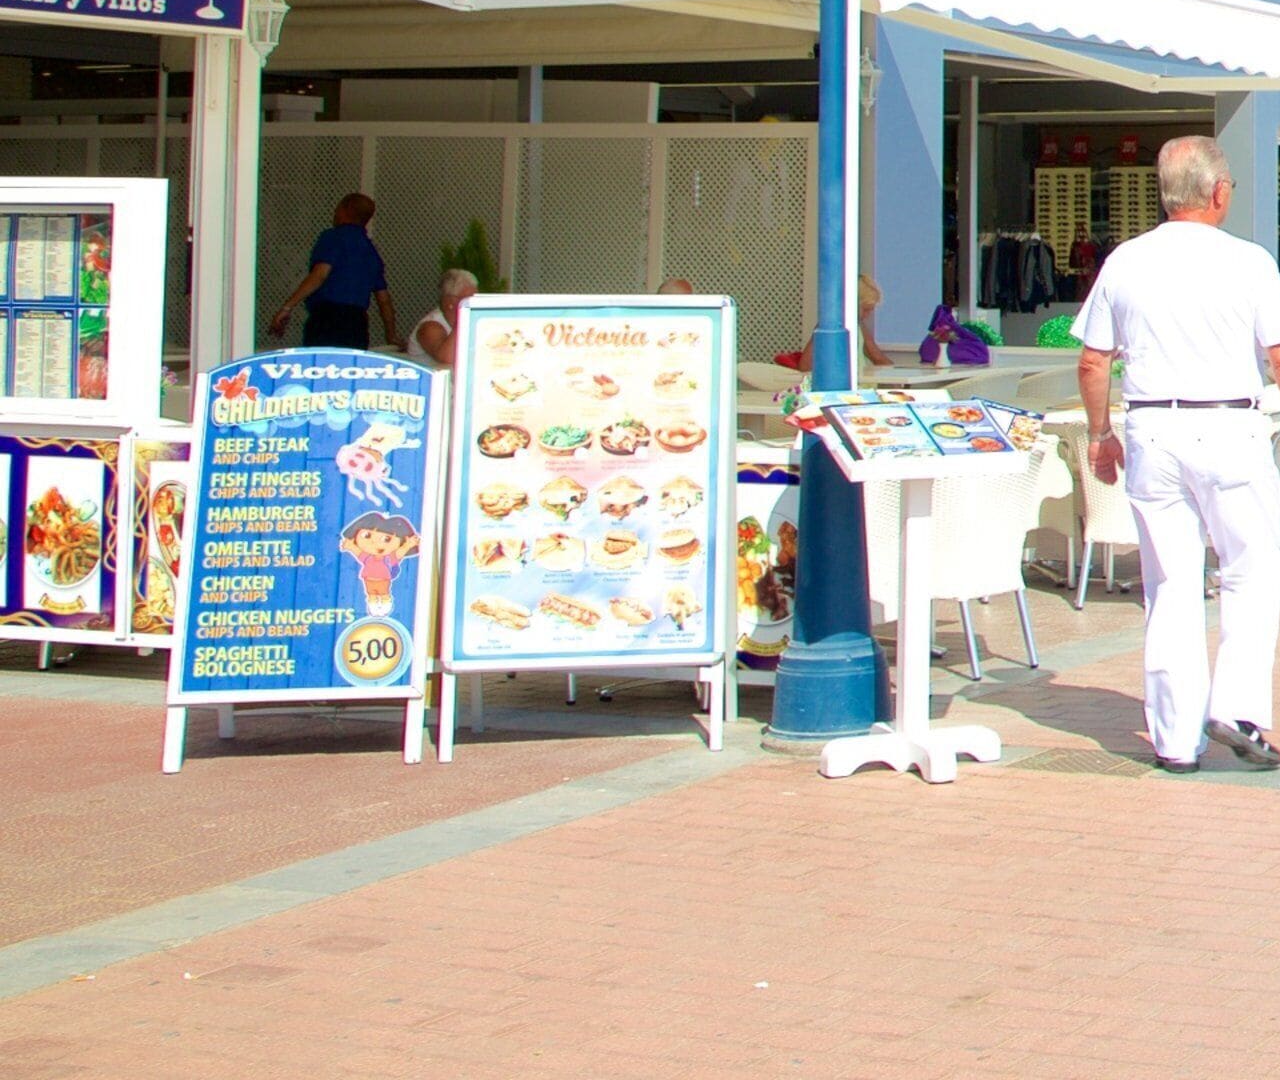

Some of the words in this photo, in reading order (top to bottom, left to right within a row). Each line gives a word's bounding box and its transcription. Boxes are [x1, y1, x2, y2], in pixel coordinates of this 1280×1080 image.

[543, 323, 650, 347] Victoria
[262, 363, 420, 380] Victoria
[213, 392, 350, 424] CHILDREN'S
[355, 390, 425, 419] MENU
[214, 438, 253, 453] BEEF
[258, 438, 309, 452] STEAK
[213, 454, 240, 465] AND
[244, 453, 280, 464] CHIPS
[211, 472, 247, 487] FISH
[252, 472, 321, 486] FINGERS
[209, 487, 245, 499] CHIPS
[249, 487, 276, 498] AND
[279, 487, 320, 498] SALAD
[208, 506, 315, 521] HAMBURGER
[206, 521, 242, 534] CHIPS
[246, 521, 273, 533] AND
[276, 520, 317, 532] BEANS
[204, 541, 291, 556] OMELETTE
[203, 556, 240, 568] CHIPS
[243, 556, 270, 567] AND
[274, 555, 315, 567] SALAD
[202, 576, 275, 591] CHICKEN
[200, 592, 228, 603] AND
[231, 591, 268, 602] CHIPS
[197, 611, 270, 626] CHICKEN
[275, 609, 355, 624] NUGGETS
[196, 626, 233, 639] CHIPS
[237, 626, 264, 638] AND
[268, 624, 310, 637] BEANS
[194, 645, 288, 662] SPAGHETTI
[349, 636, 398, 666] 5,00
[193, 660, 295, 677] BOLOGNESE
